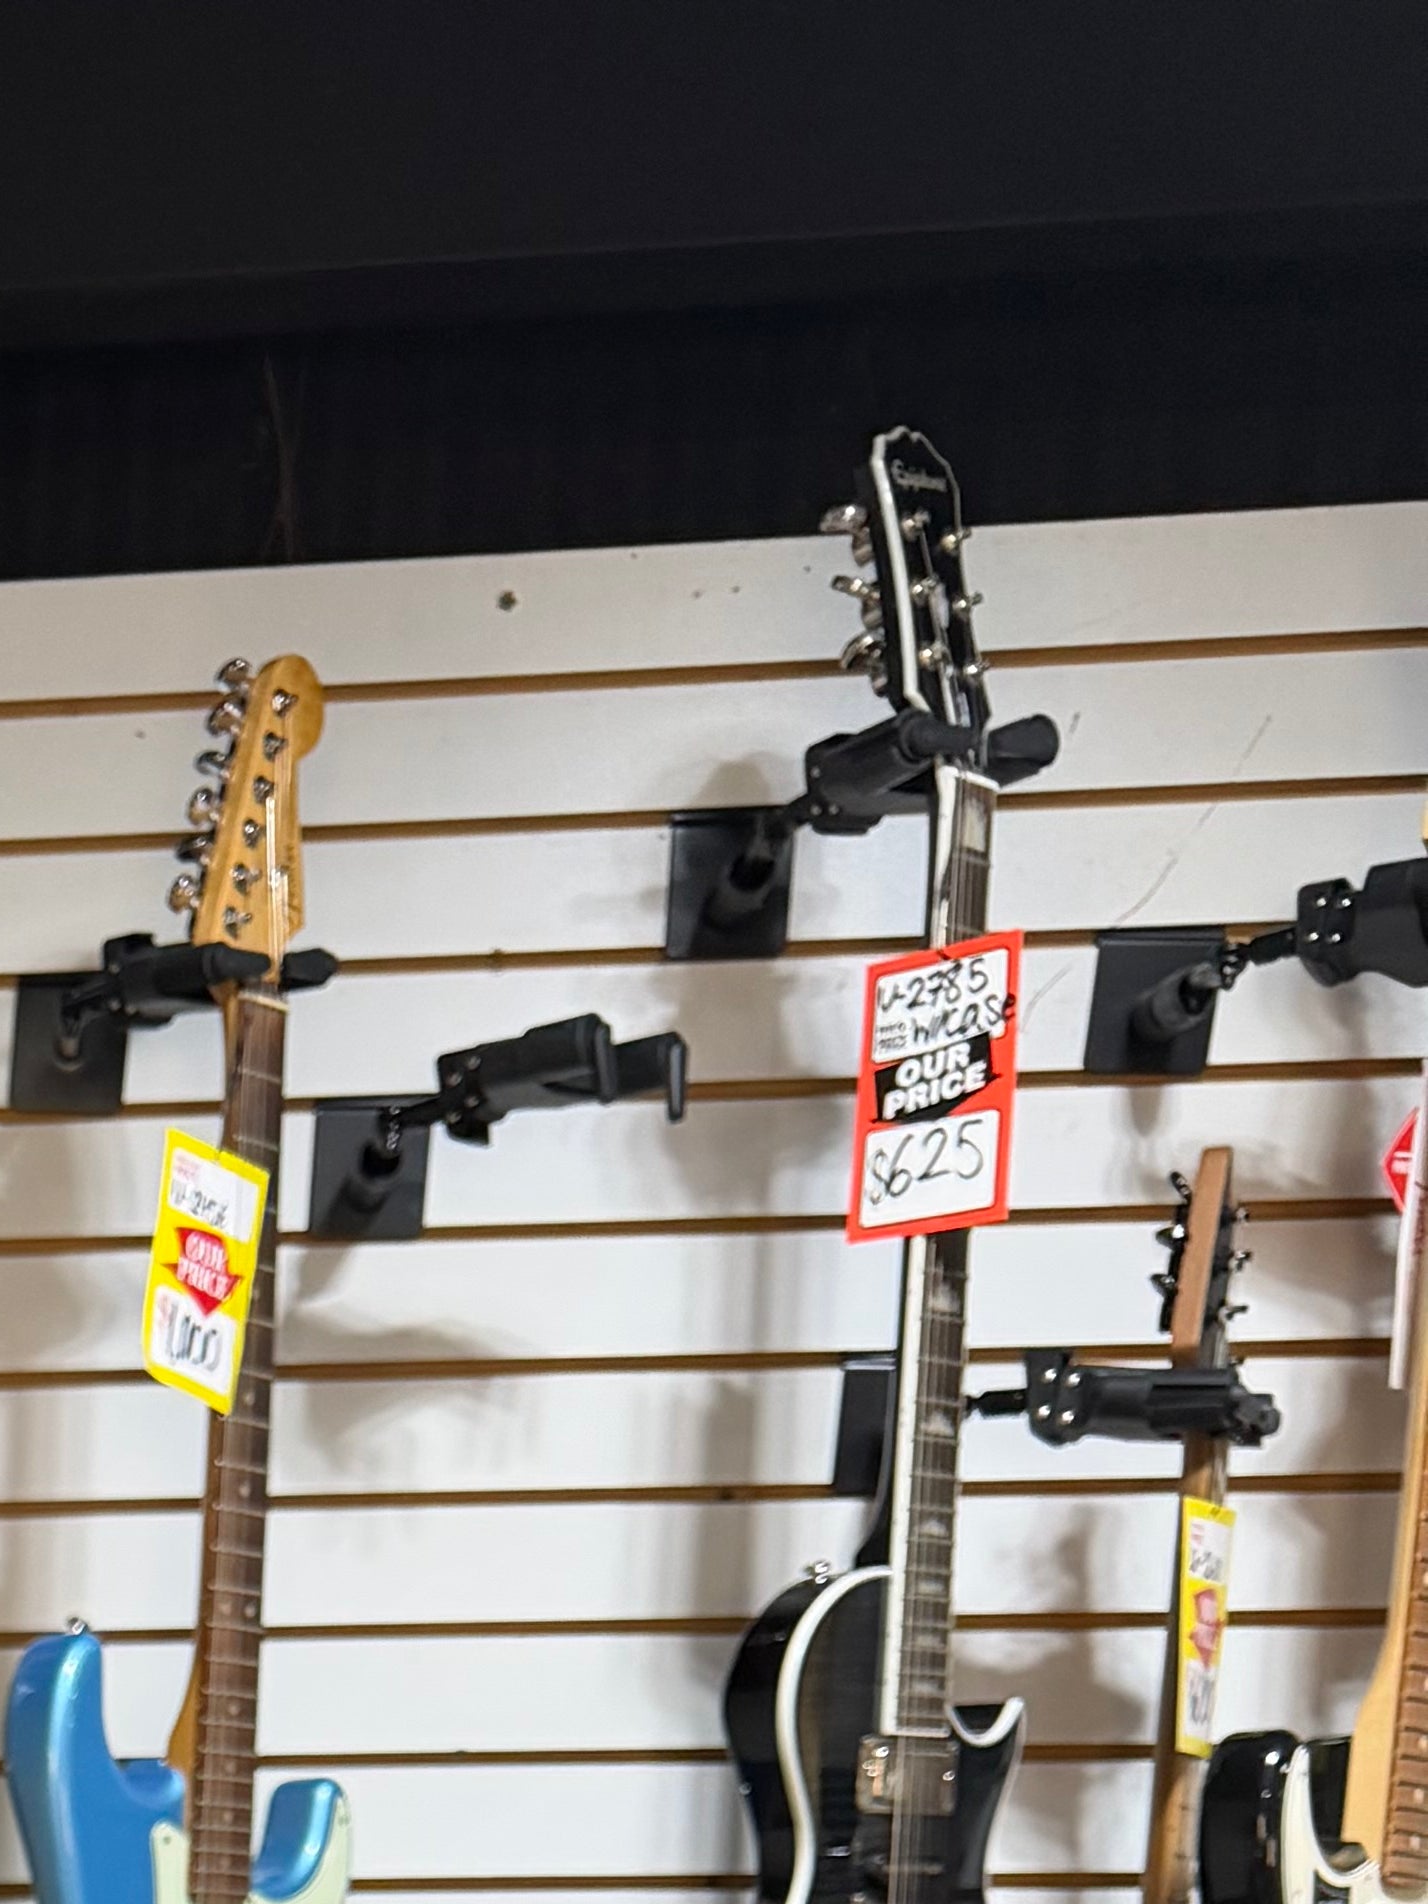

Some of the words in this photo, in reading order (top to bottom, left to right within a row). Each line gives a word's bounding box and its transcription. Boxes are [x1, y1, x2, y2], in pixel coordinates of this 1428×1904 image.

[881, 1060, 988, 1122] PRICE
[895, 1041, 971, 1087] OUR
[867, 1118, 985, 1206] $625
